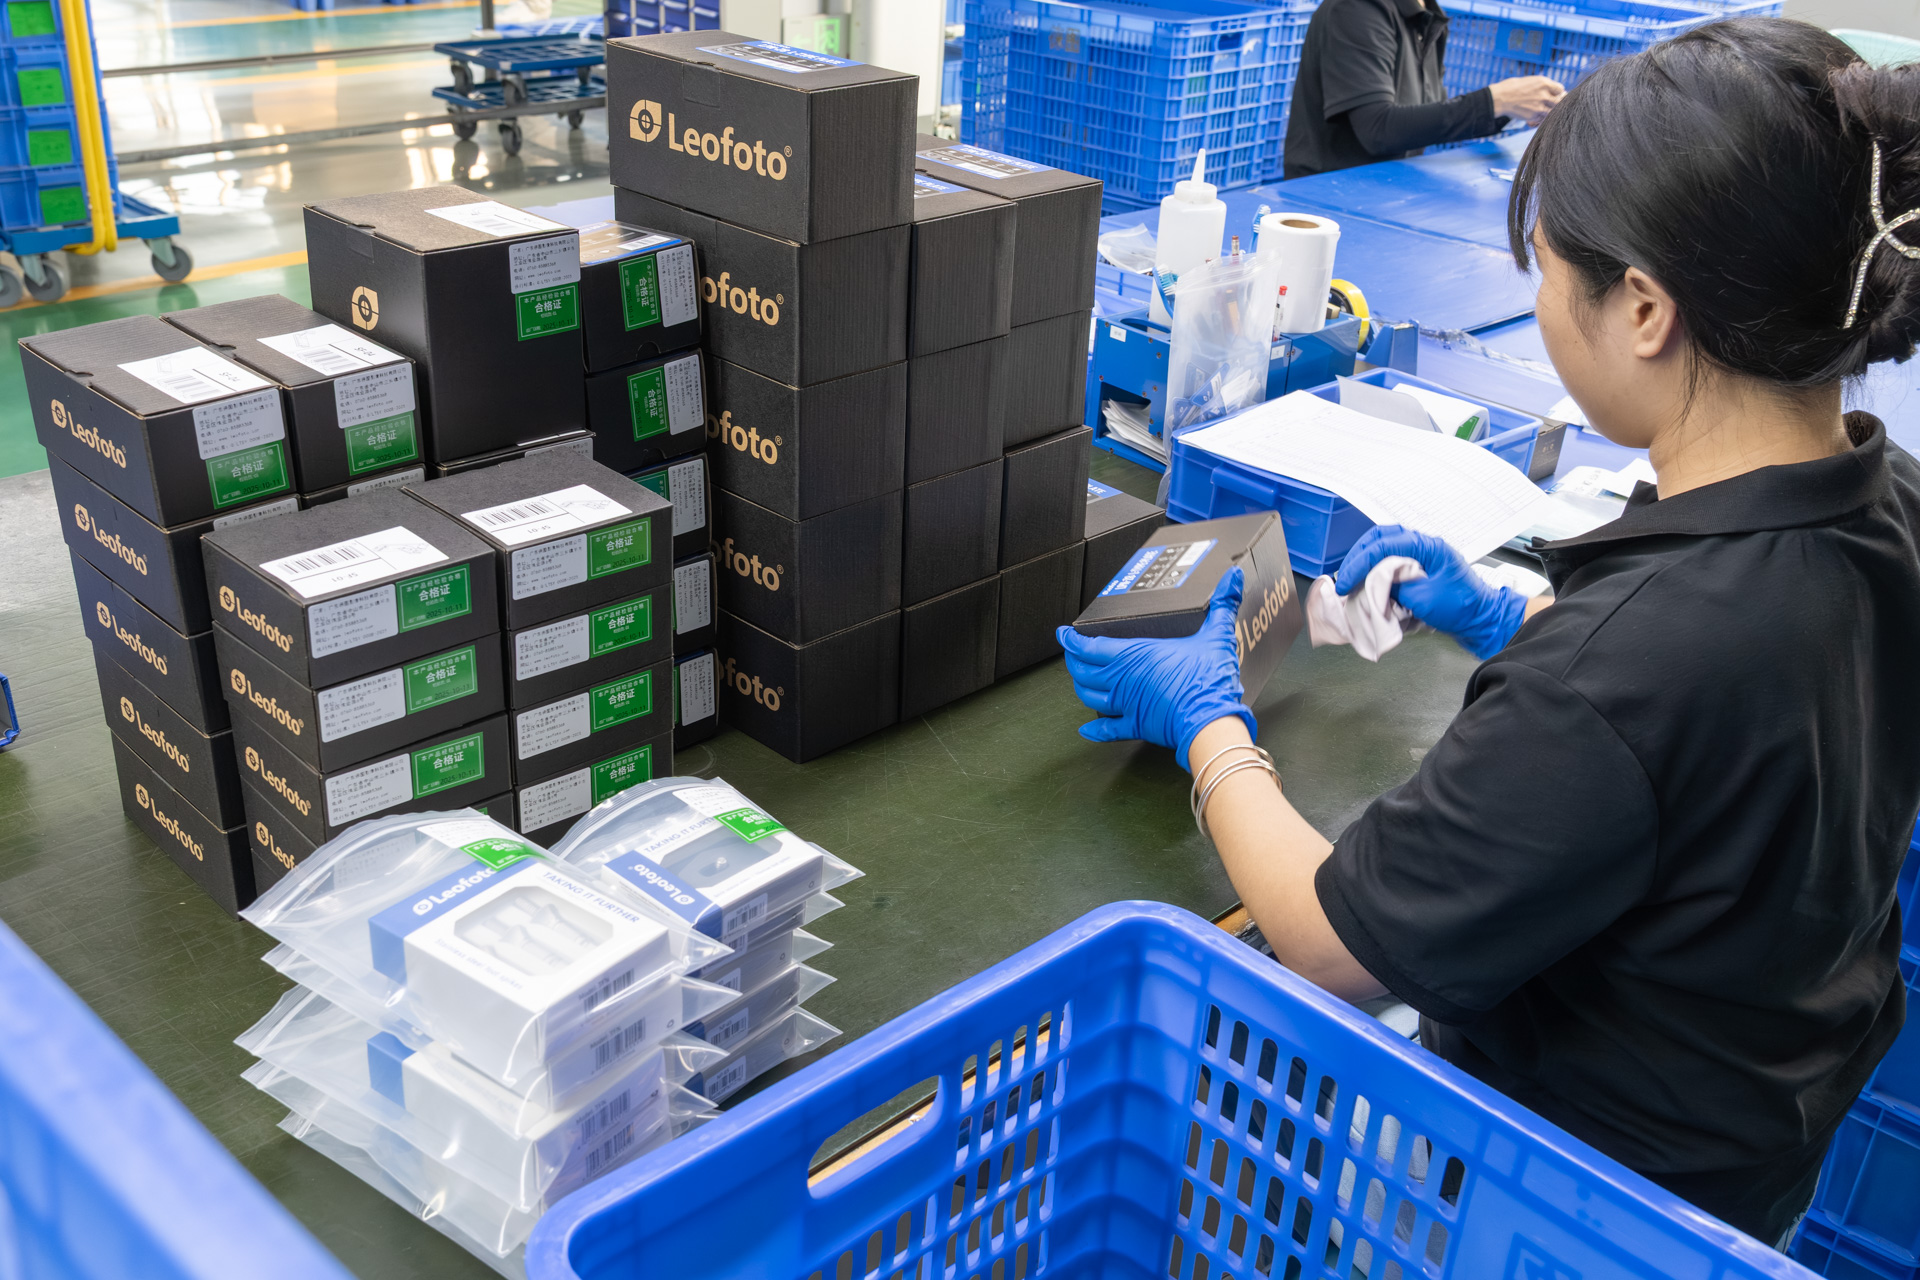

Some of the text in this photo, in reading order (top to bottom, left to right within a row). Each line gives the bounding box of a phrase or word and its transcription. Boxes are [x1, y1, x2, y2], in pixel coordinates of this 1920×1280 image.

[639, 277, 650, 306] 合格证
[534, 299, 562, 314] 合格证
[366, 430, 397, 446] 合格证
[231, 460, 264, 478] 合格证
[606, 535, 634, 552] 合格证
[418, 584, 451, 602] 合格证
[425, 603, 463, 619] 2025-10-11
[607, 613, 635, 630] 合格证
[425, 666, 457, 684] 合格证
[608, 688, 636, 705] 合格证
[433, 752, 464, 770] 合格证
[609, 762, 636, 780] 合格证
[270, 834, 299, 871] Leof
[634, 863, 683, 899] Leofoto
[543, 871, 584, 894] TAKING
[583, 891, 595, 899] IT
[593, 897, 640, 923] FURTHER
